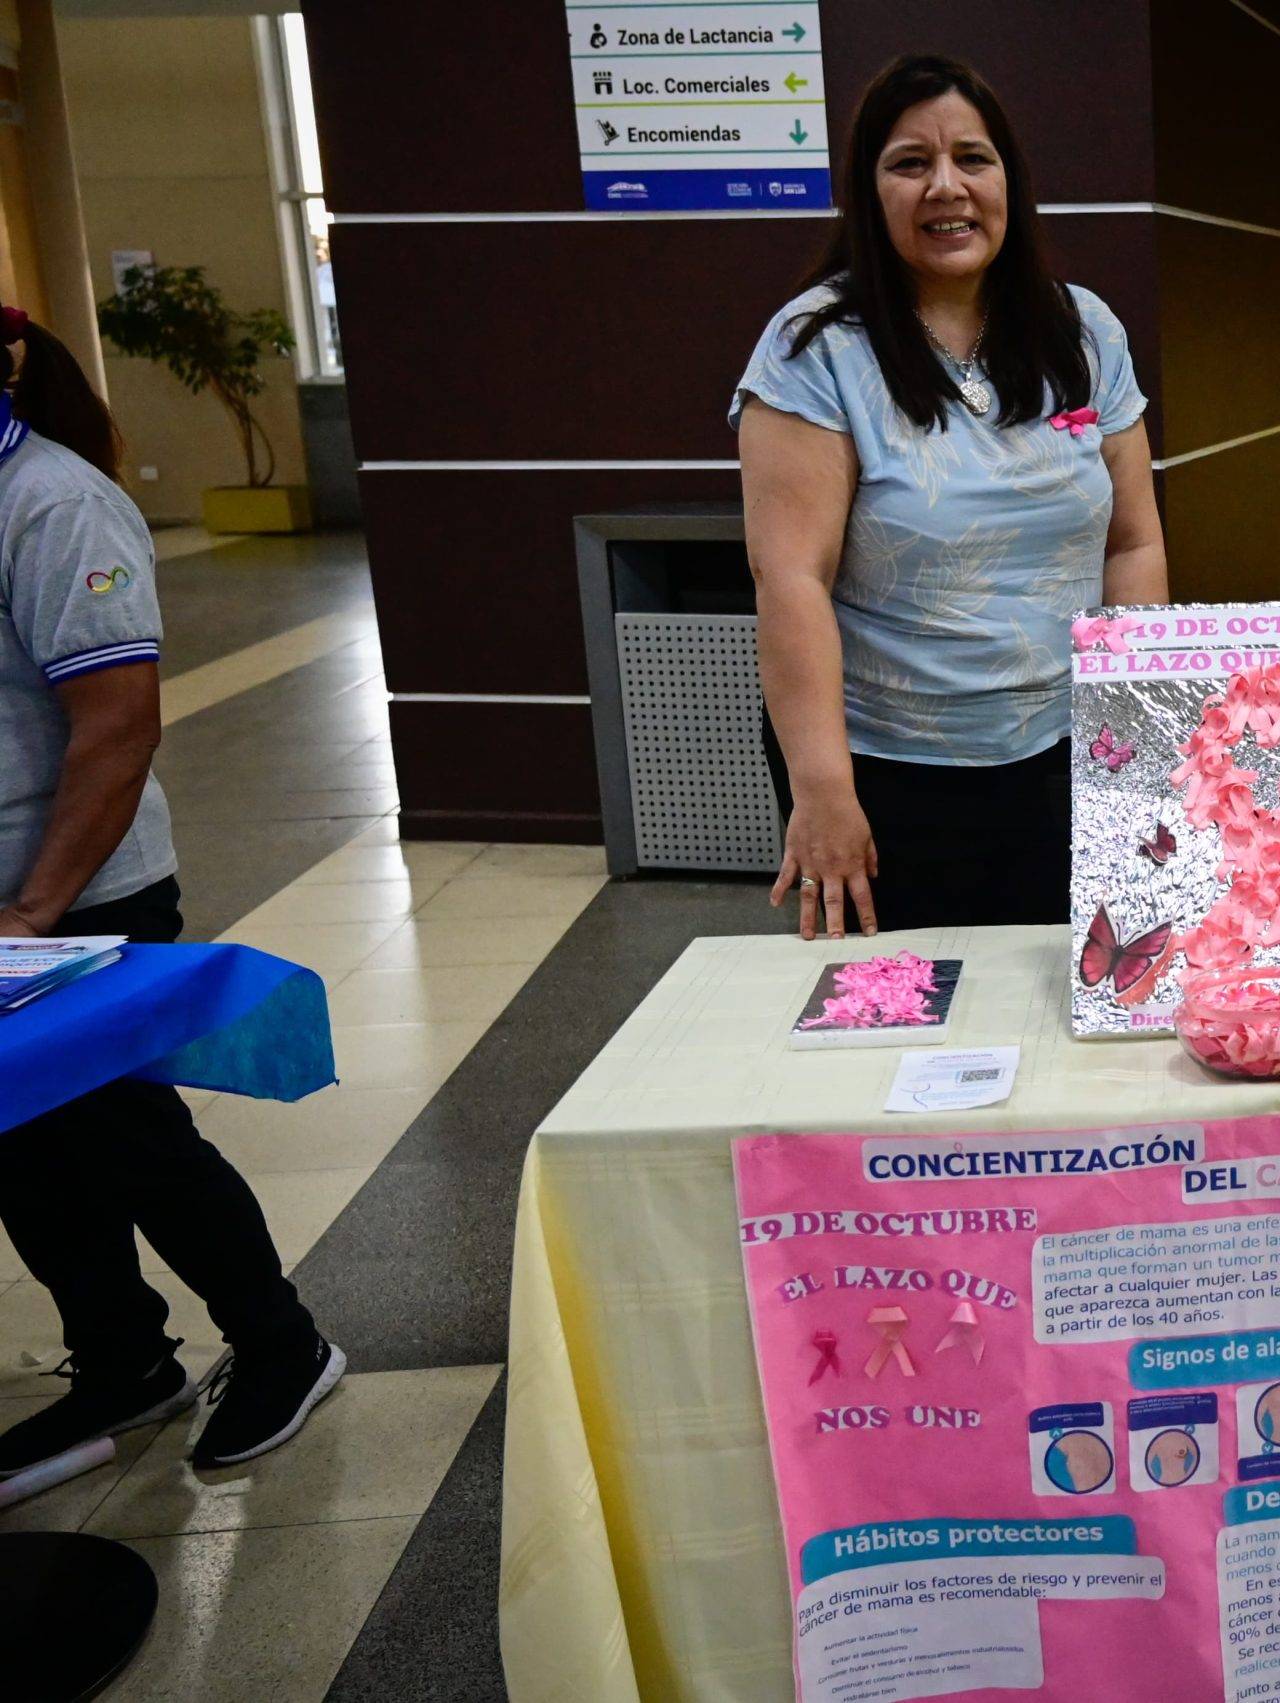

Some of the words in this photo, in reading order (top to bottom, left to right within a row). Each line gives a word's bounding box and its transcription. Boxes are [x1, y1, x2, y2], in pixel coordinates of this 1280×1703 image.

[617, 29, 659, 46] Zona
[665, 28, 685, 45] de
[690, 26, 774, 45] Lactancia
[623, 78, 659, 95] Loc.
[665, 76, 770, 94] Comerciales
[628, 125, 741, 143] Encomiendas
[1133, 622, 1167, 640] 19
[1175, 618, 1218, 636] DE
[1078, 655, 1117, 674] EL
[1126, 652, 1212, 673] LAZO
[868, 1134, 1195, 1179] CONCIENTIZACIÓN
[1185, 1166, 1247, 1193] DEL
[741, 1220, 783, 1243] 19
[792, 1211, 847, 1236] DE
[854, 1208, 1037, 1236] OCTUBRE
[1042, 1236, 1055, 1250] El
[1061, 1233, 1110, 1248] cáncer
[1116, 1227, 1135, 1241] de
[1140, 1226, 1186, 1240] mama
[1192, 1223, 1209, 1236] es
[1215, 1222, 1241, 1234] una
[1043, 1254, 1055, 1267] la
[1060, 1243, 1167, 1264] multiplicación
[1172, 1237, 1236, 1255] anormal
[1241, 1236, 1260, 1249] de
[1044, 1269, 1092, 1284] mama
[1097, 1264, 1127, 1279] que
[1130, 1262, 1187, 1275] forman
[1193, 1259, 1212, 1270] un
[1218, 1253, 1264, 1267] tumor
[775, 1272, 825, 1304] EL
[834, 1265, 934, 1291] LAZO
[940, 1268, 1019, 1311] QUE
[1044, 1284, 1099, 1301] afectar
[1104, 1283, 1113, 1294] a
[1119, 1276, 1191, 1293] cualquier
[1196, 1272, 1246, 1288] mujer.
[1252, 1269, 1278, 1282] Las
[1045, 1304, 1074, 1319] que
[1080, 1299, 1150, 1314] aparezca
[1155, 1290, 1234, 1307] aumentan
[1237, 1288, 1265, 1300] con
[1046, 1323, 1055, 1334] a
[1060, 1319, 1101, 1334] partir
[1107, 1315, 1127, 1329] de
[1132, 1313, 1154, 1326] los
[1158, 1312, 1178, 1324] 40
[1183, 1308, 1224, 1323] años.
[1142, 1347, 1216, 1371] Signos
[1221, 1340, 1250, 1361] de
[814, 1405, 891, 1434] NOS
[906, 1405, 982, 1429] UNE
[834, 1527, 940, 1558] Hábitos
[949, 1525, 1104, 1548] protectores
[1225, 1537, 1240, 1550] La
[1225, 1546, 1276, 1565] cuando
[829, 1581, 899, 1606] disminuir
[905, 1579, 927, 1590] los
[932, 1575, 993, 1588] factores
[998, 1572, 1016, 1585] de
[1022, 1572, 1067, 1587] riesgo
[1072, 1574, 1081, 1587] y
[1086, 1573, 1144, 1587] prevenir
[1150, 1574, 1162, 1586] el
[1246, 1578, 1263, 1592] En
[799, 1608, 838, 1638] cáncer
[844, 1602, 862, 1616] de
[868, 1595, 913, 1611] mama
[918, 1592, 935, 1603] es
[940, 1586, 1047, 1601] recomendable:
[1227, 1593, 1273, 1613] menos
[1228, 1609, 1273, 1629] cáncer
[1229, 1627, 1261, 1645] 90%
